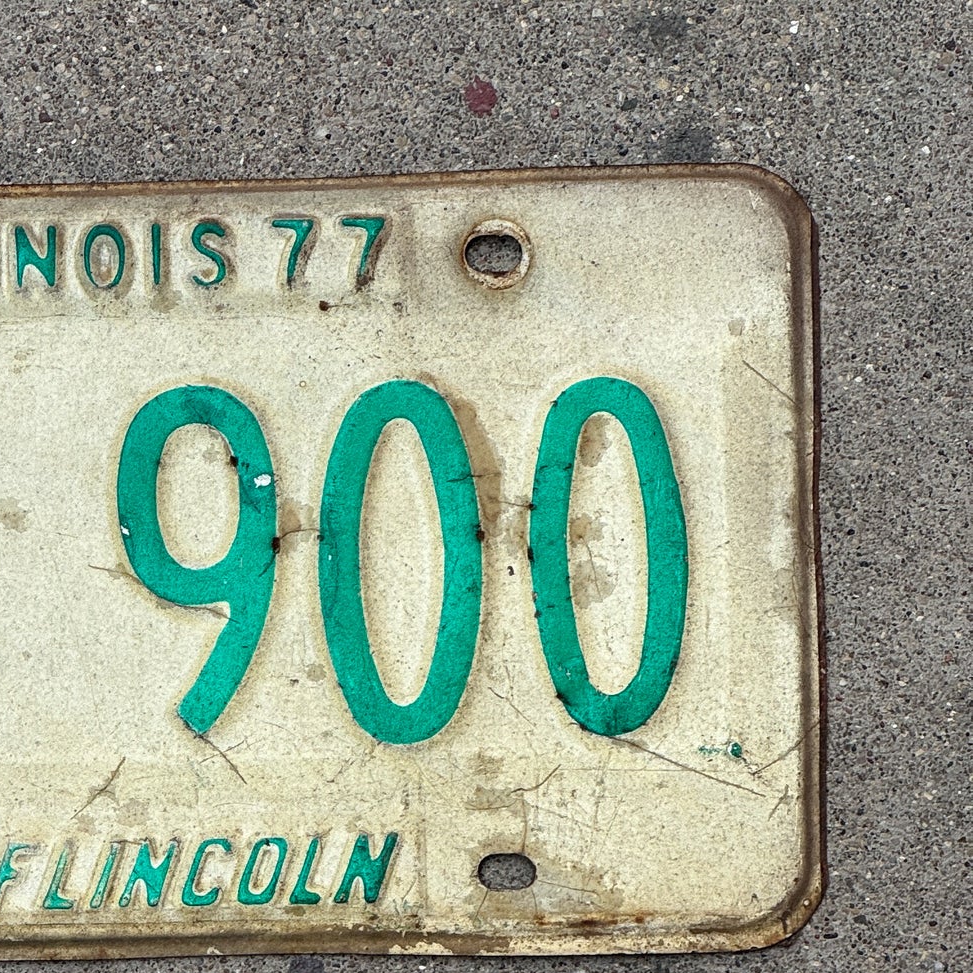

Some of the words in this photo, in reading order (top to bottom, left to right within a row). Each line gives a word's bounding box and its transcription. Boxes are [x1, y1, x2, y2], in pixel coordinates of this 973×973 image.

[271, 216, 386, 287] 77
[115, 376, 690, 746] 900
[41, 832, 398, 910] LINCOLN
